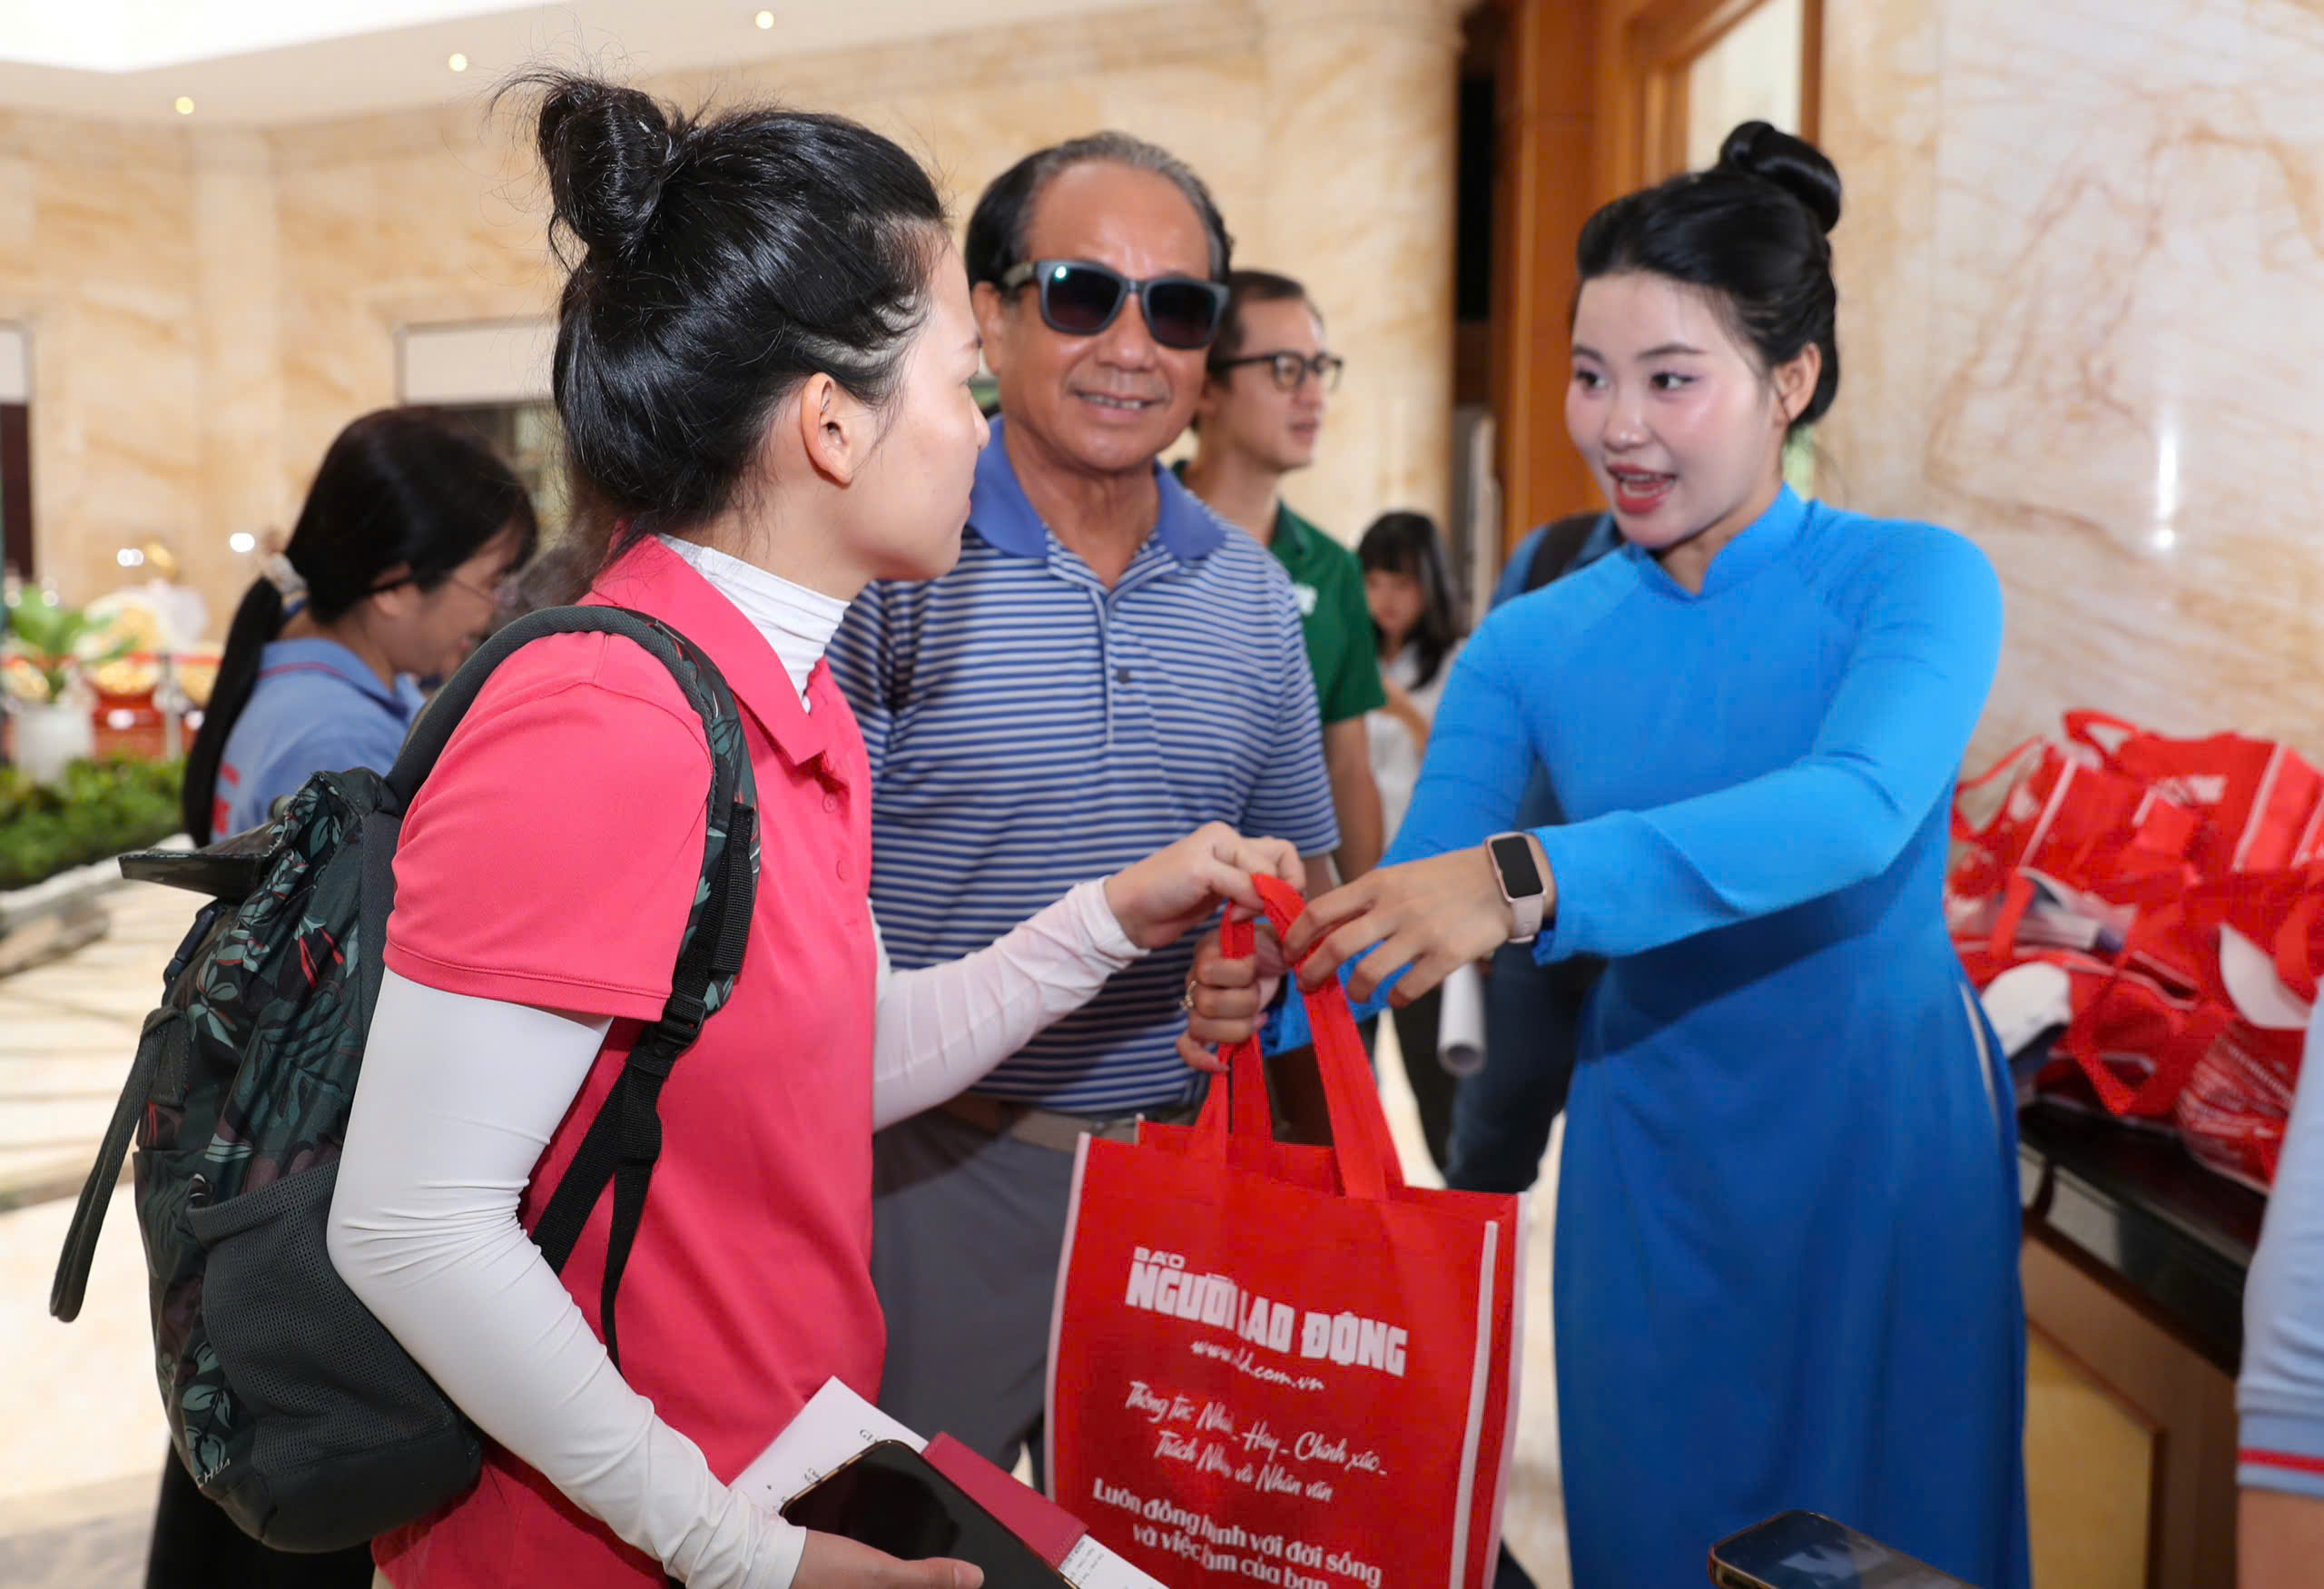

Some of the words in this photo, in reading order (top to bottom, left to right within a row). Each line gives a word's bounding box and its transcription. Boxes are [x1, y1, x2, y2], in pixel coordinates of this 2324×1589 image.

[1237, 1289, 1295, 1354] LAO
[1300, 1310, 1407, 1377] ĐỘNG
[1242, 1420, 1281, 1463] Hay
[1256, 1462, 1303, 1495] Nhân
[1092, 1477, 1142, 1515] Luôn
[1249, 1533, 1284, 1559] với
[1325, 1551, 1383, 1589] sống
[1240, 1555, 1282, 1584] của
